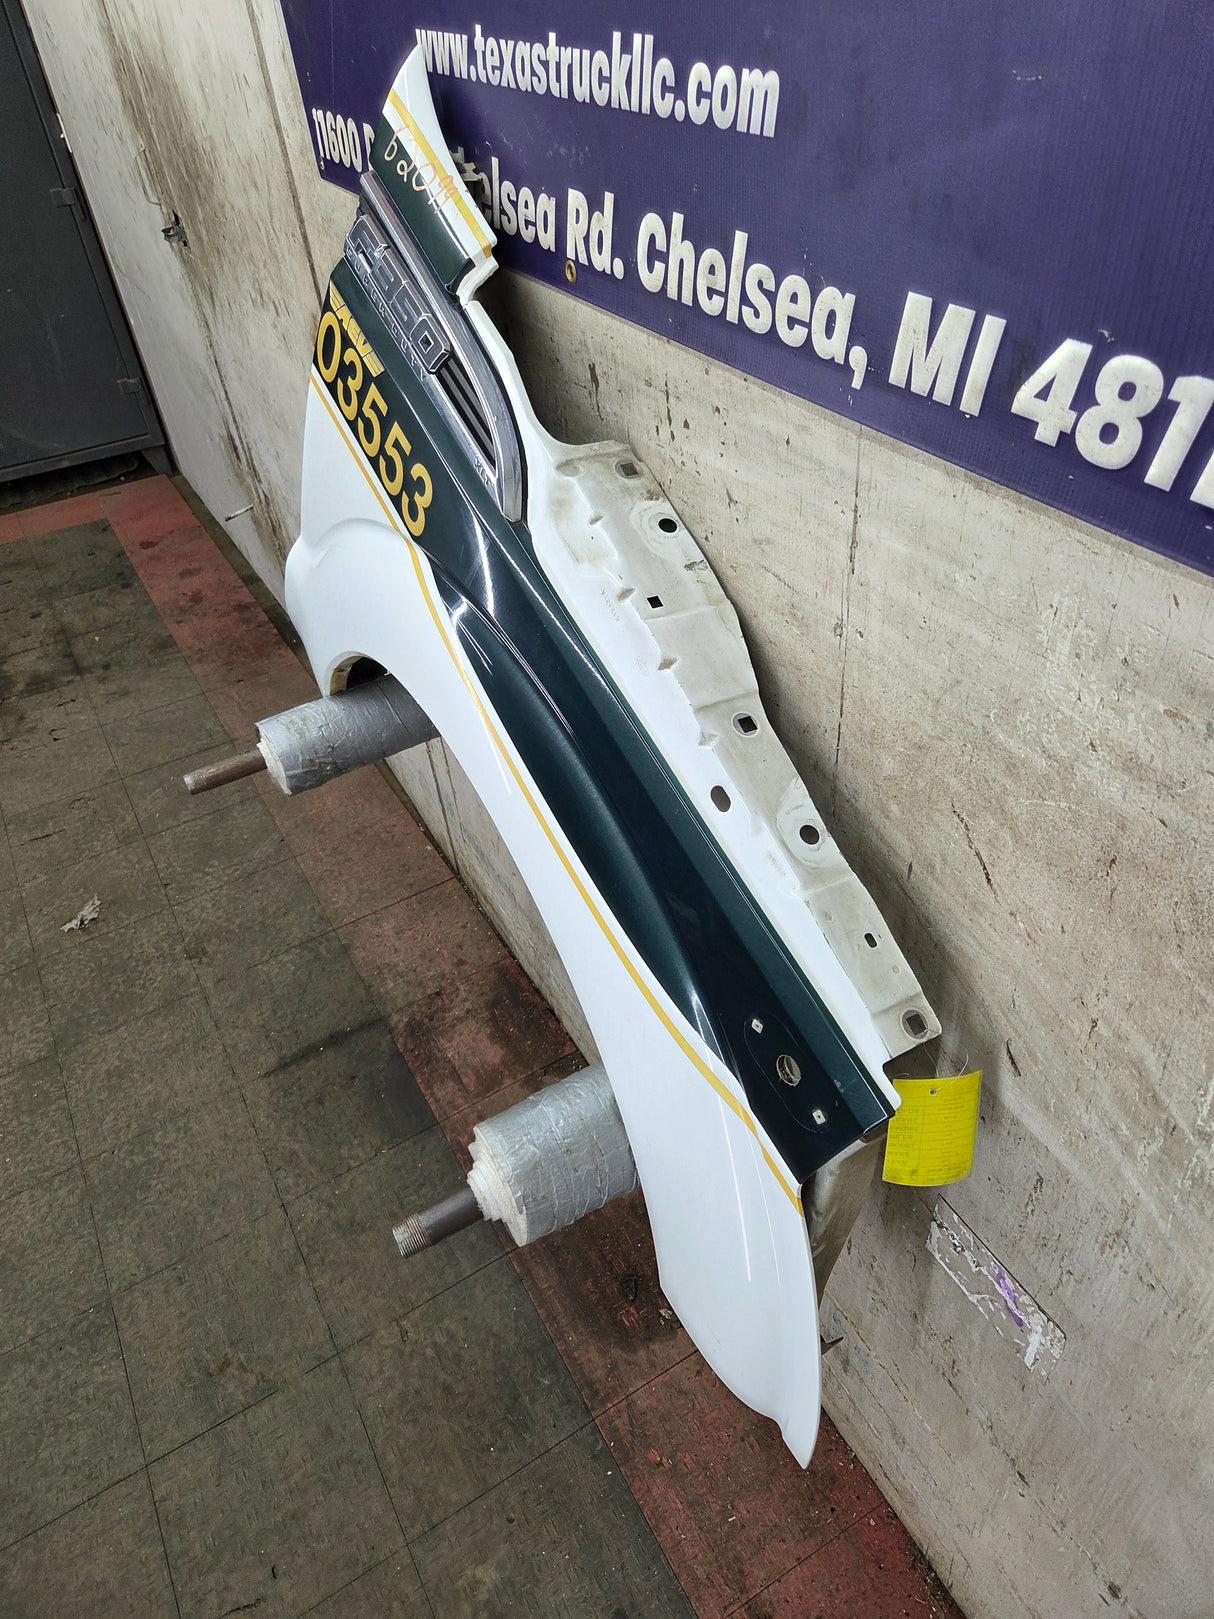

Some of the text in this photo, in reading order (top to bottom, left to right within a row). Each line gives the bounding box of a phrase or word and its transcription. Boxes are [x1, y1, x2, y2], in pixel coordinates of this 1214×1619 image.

[312, 108, 362, 172] 11600
[567, 187, 625, 280] Rd.
[637, 211, 868, 390] Chelsea,
[888, 291, 1007, 417] MI
[1011, 337, 1214, 512] 481
[316, 311, 432, 537] 03553
